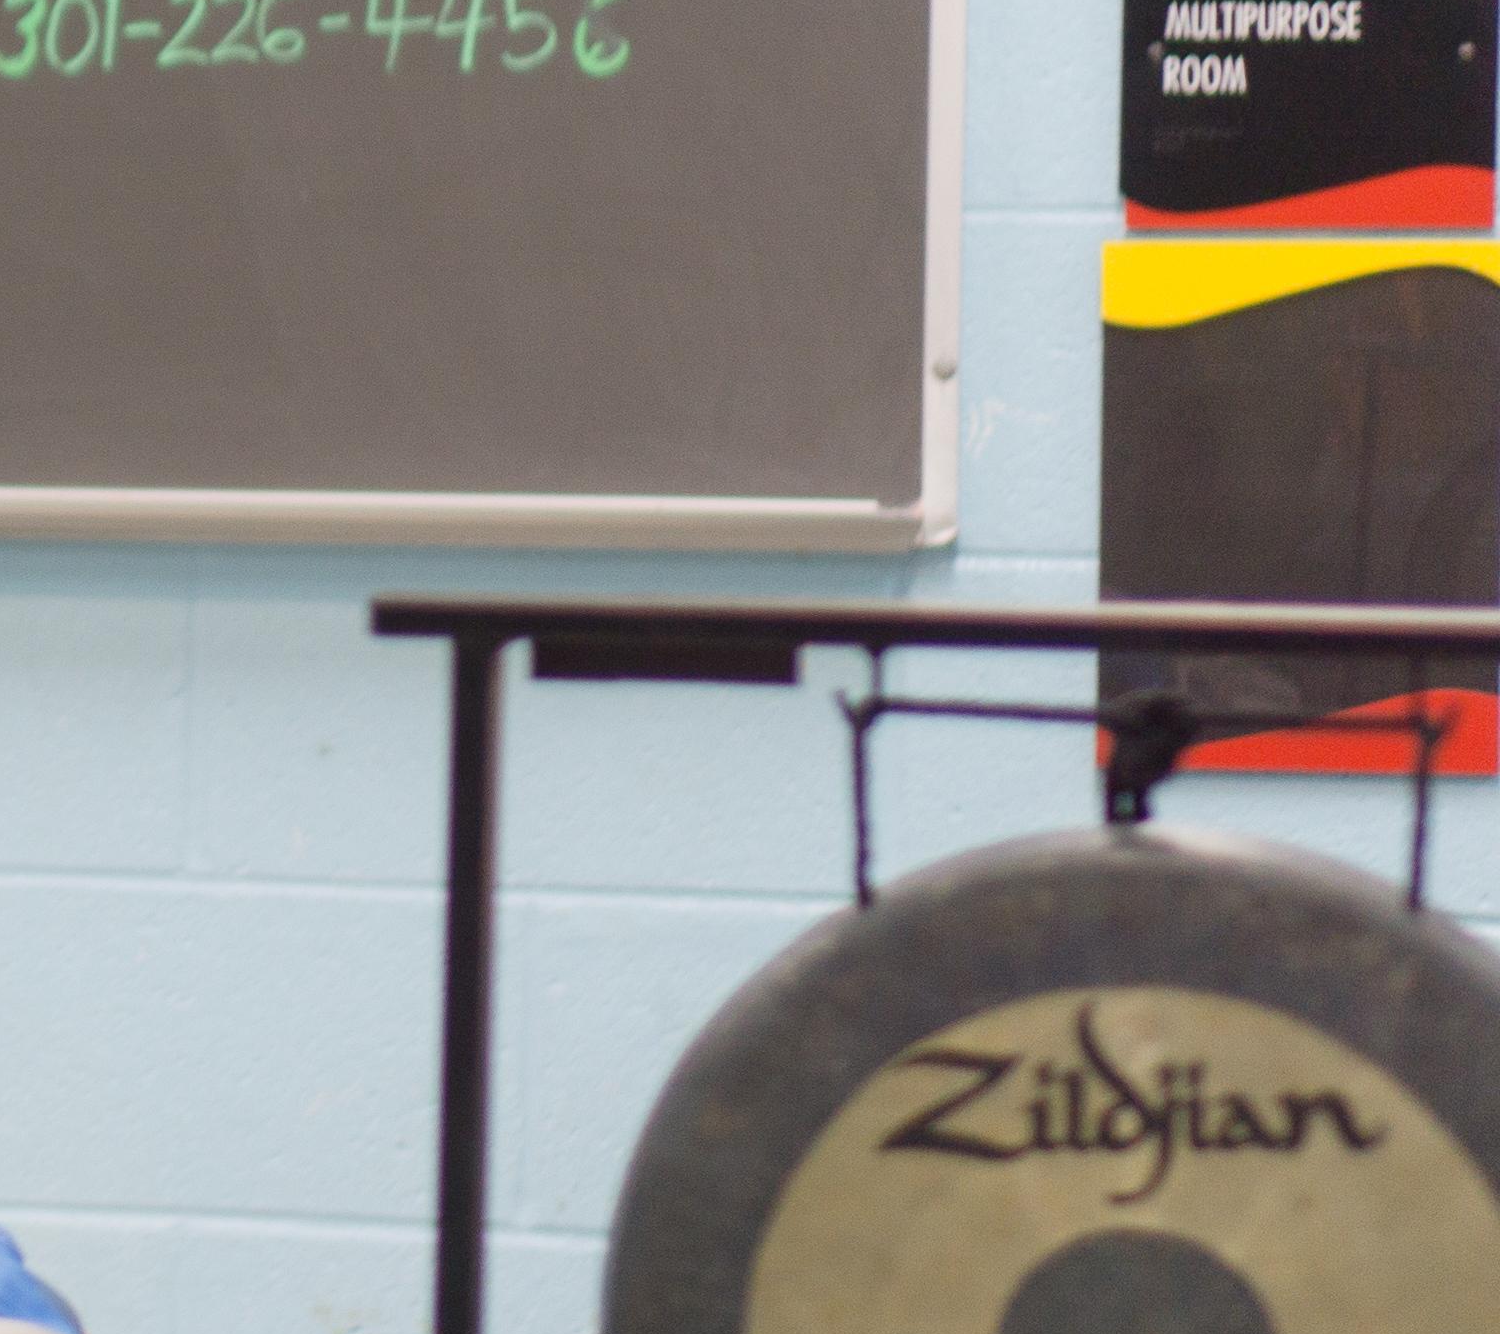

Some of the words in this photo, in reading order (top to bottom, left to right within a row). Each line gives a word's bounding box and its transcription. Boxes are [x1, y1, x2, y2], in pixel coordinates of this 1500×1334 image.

[1164, 0, 1362, 41] MULTIPURPOSE
[1162, 54, 1247, 95] ROOM
[878, 1003, 1390, 1207] Zildjian
